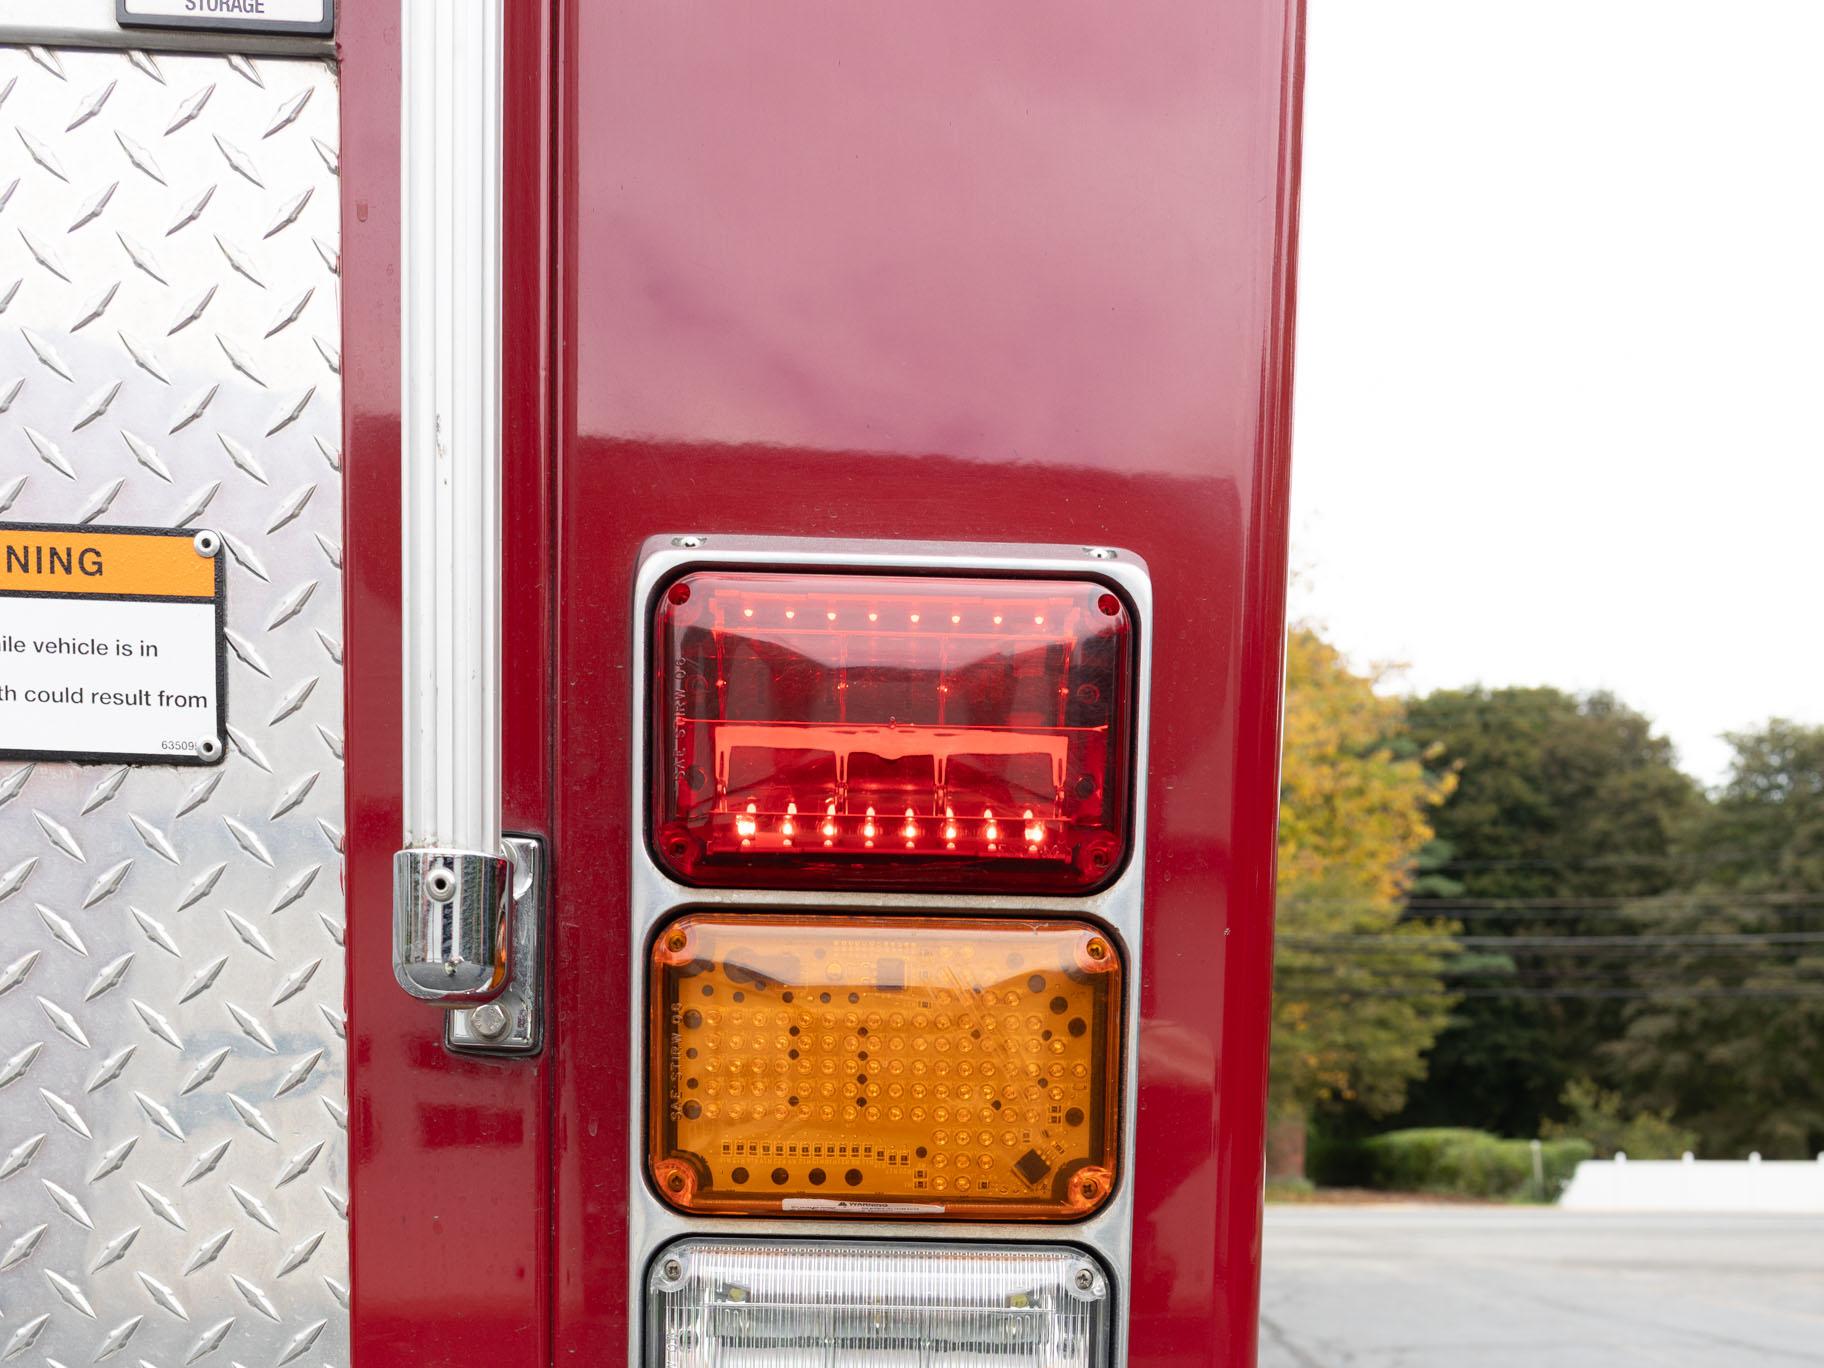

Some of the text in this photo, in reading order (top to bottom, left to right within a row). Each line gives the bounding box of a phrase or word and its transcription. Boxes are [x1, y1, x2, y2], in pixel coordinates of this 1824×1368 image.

[185, 0, 265, 13] STORAGE
[6, 545, 103, 576] NING
[33, 638, 108, 656] vehicle
[117, 640, 133, 657] is
[141, 640, 158, 657] in
[25, 688, 84, 704] could
[92, 689, 151, 706] result
[158, 691, 208, 708] from
[161, 740, 198, 751] 63509
